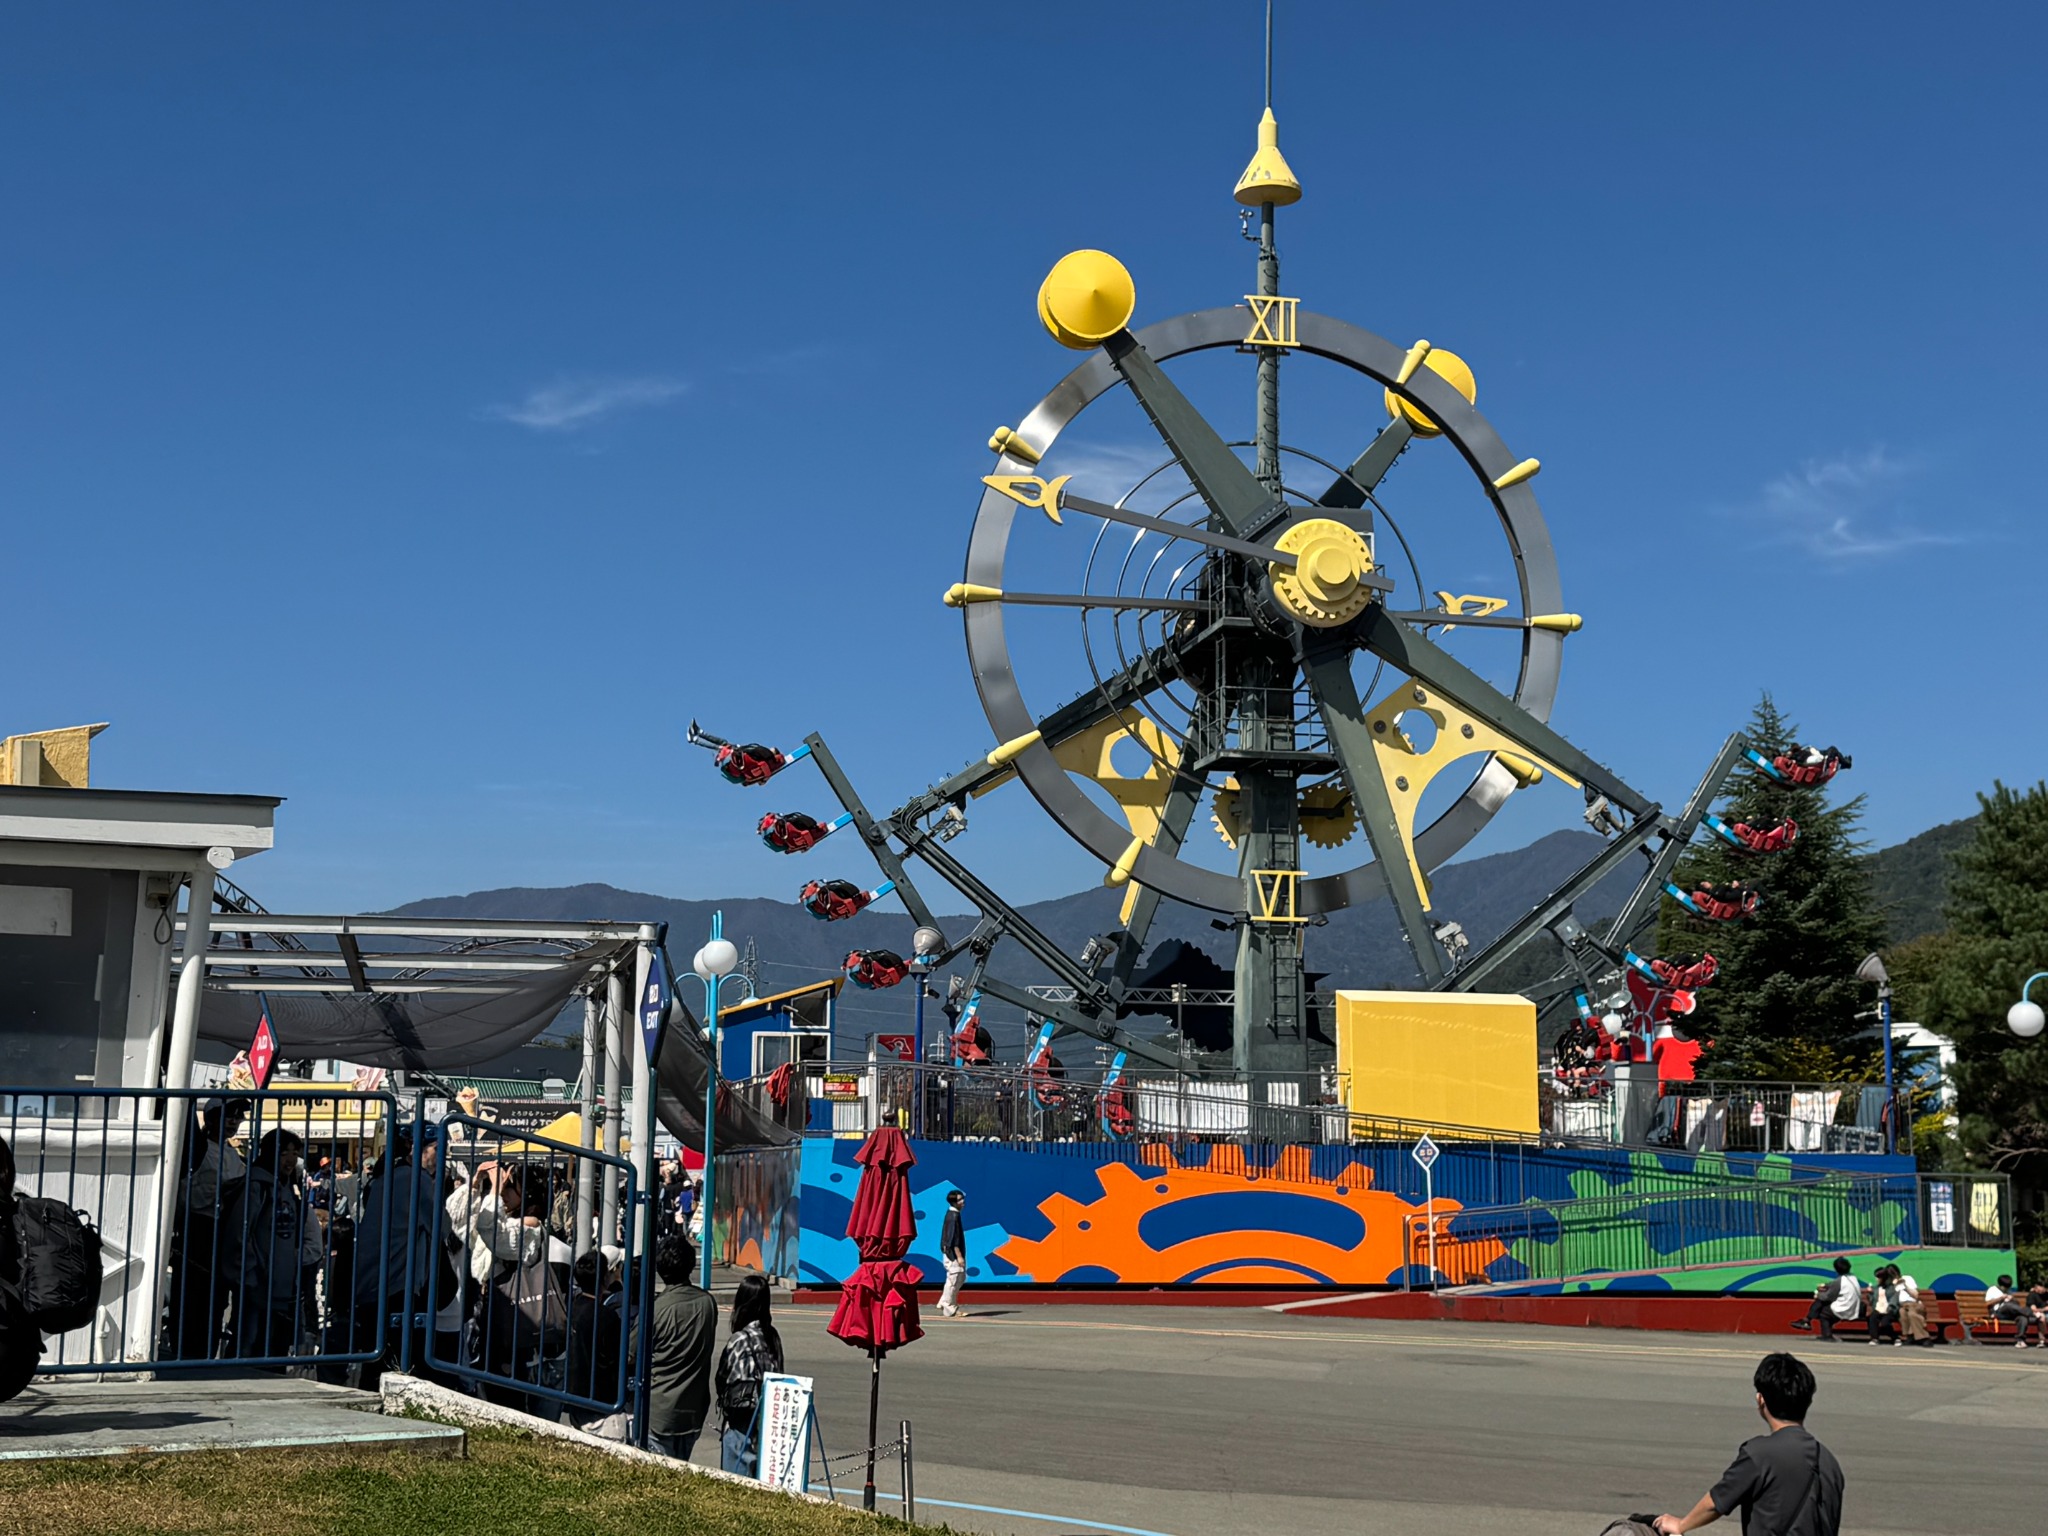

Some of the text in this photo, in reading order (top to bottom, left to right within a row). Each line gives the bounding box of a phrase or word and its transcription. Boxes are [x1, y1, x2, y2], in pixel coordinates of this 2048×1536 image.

[1243, 295, 1301, 347] XII
[1250, 869, 1309, 922] VI
[646, 1010, 659, 1030] EXIT
[500, 1118, 529, 1126] MOMI
[778, 1386, 791, 1485] ありがとう
